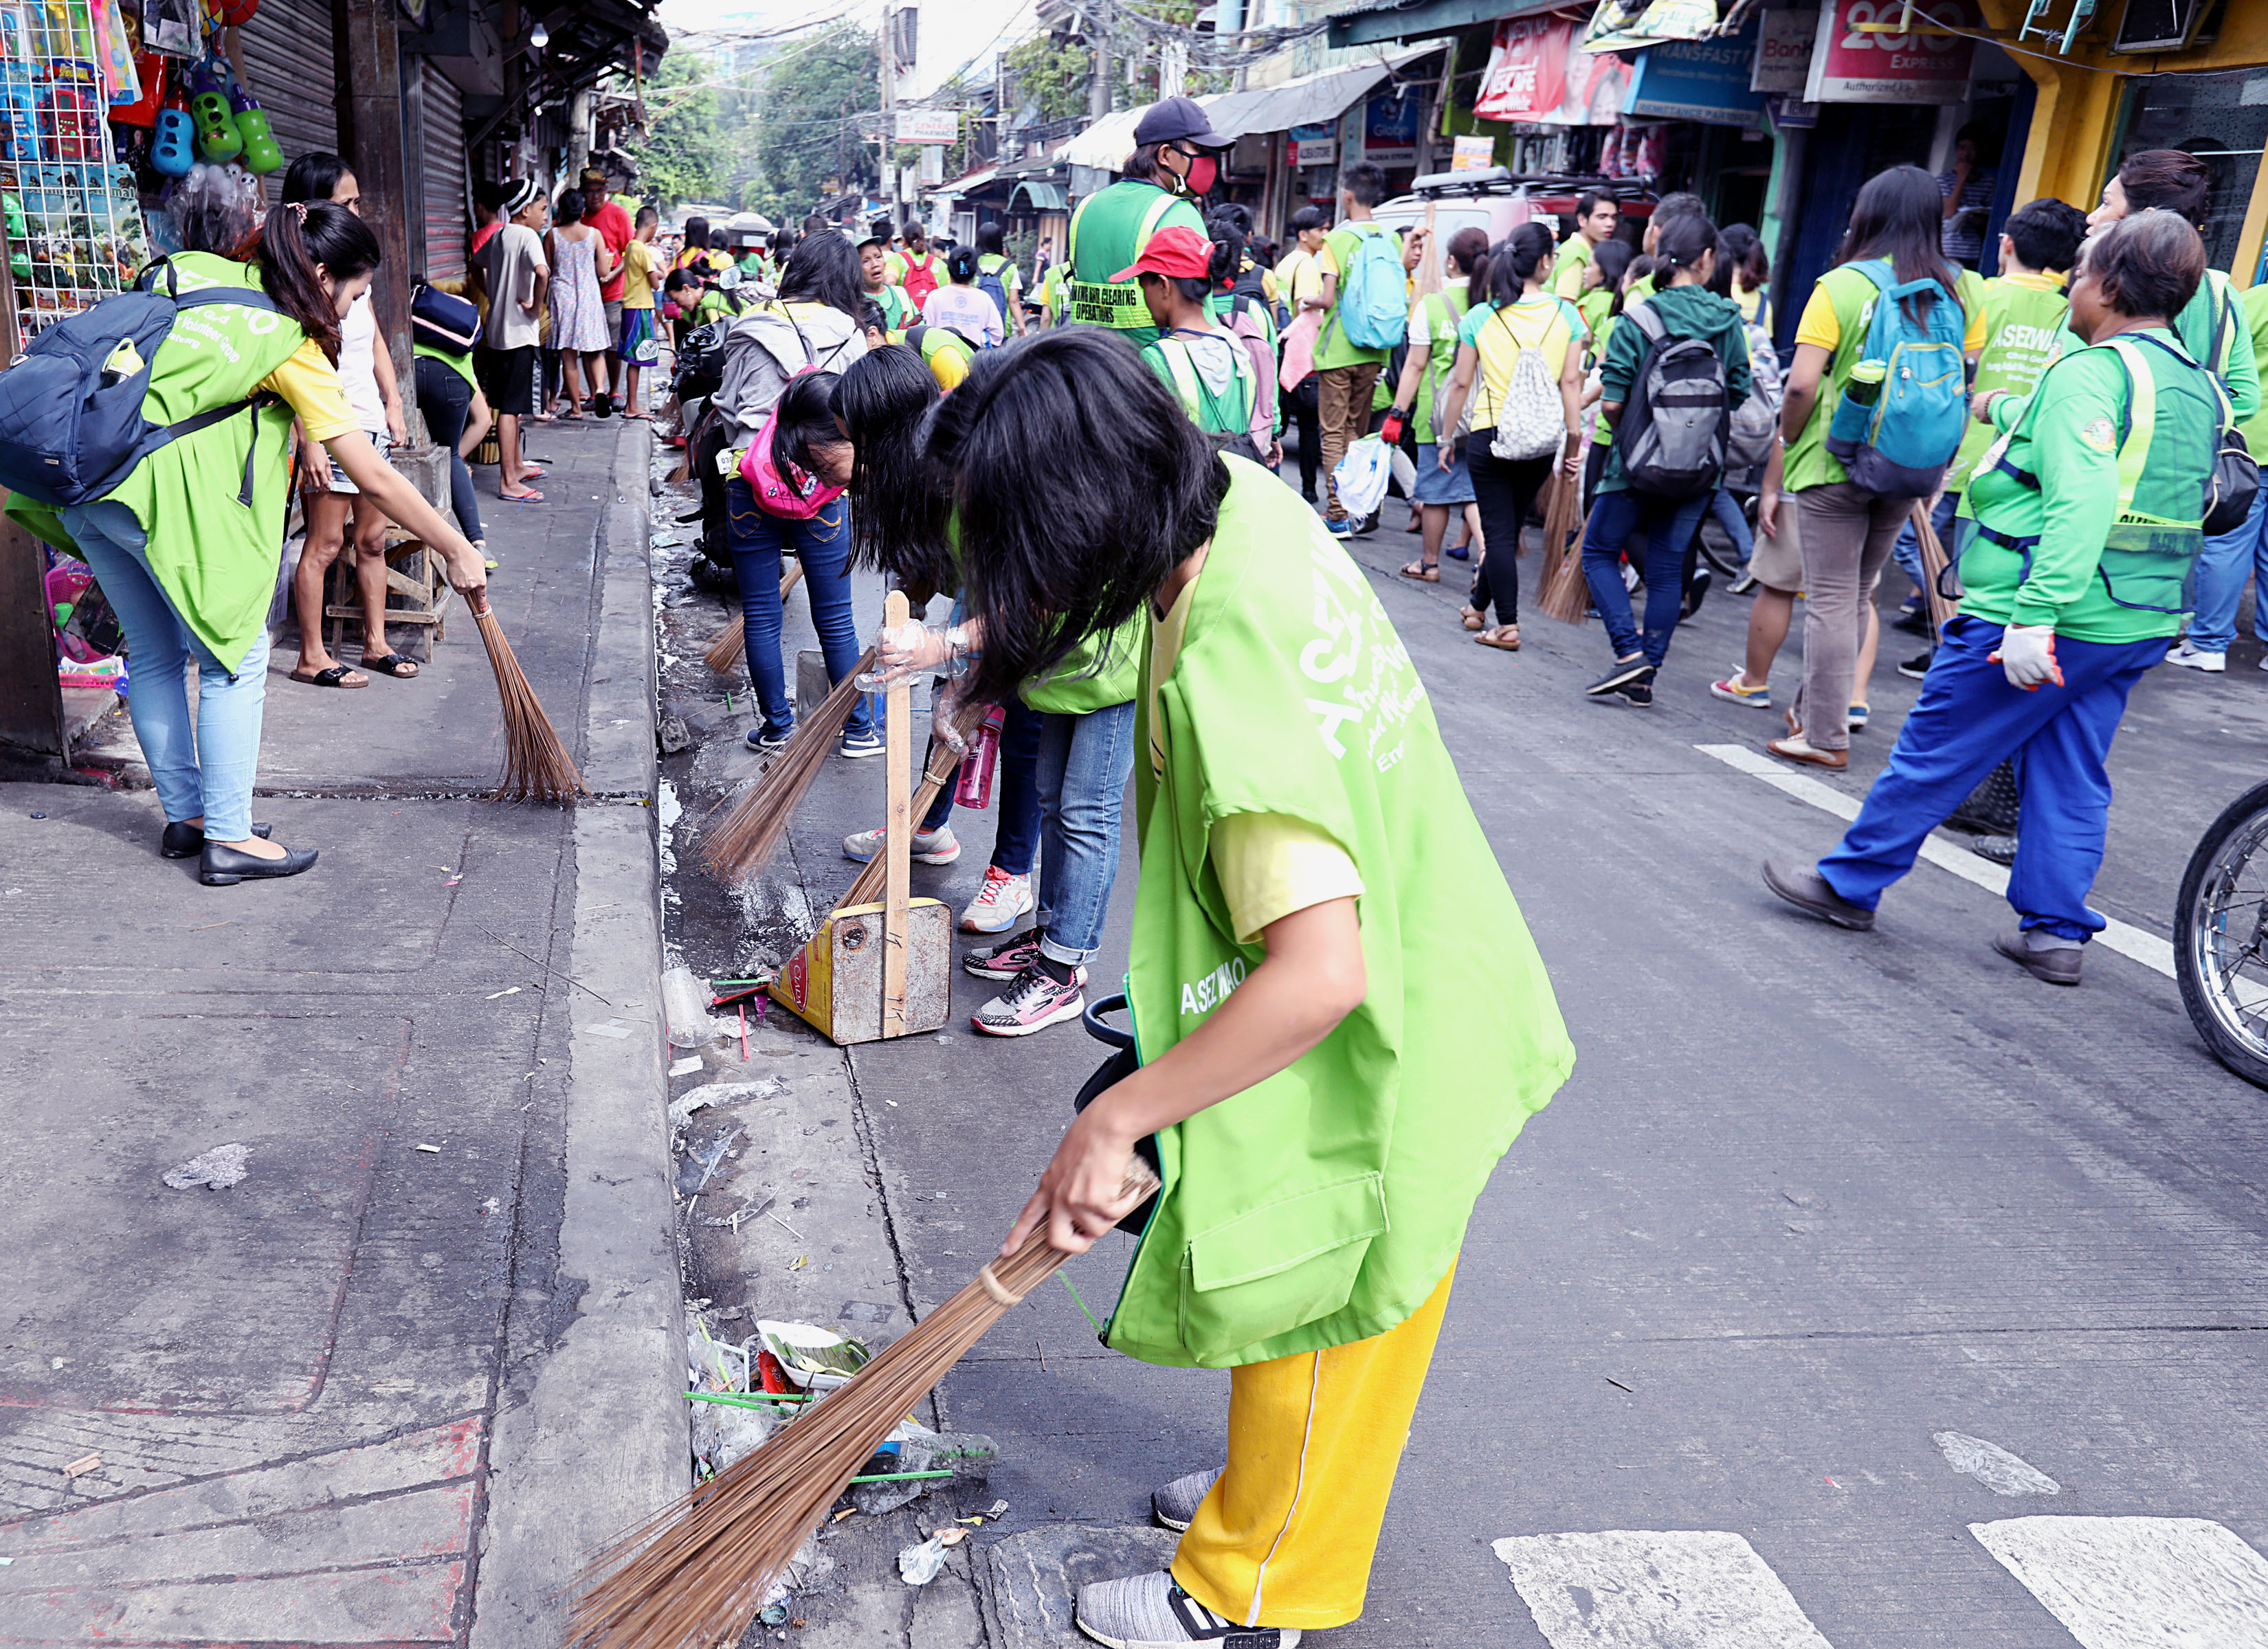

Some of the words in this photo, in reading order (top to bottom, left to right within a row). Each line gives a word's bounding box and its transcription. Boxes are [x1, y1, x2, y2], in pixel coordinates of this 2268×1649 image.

[1842, 81, 1896, 93] Authorized
[1373, 124, 1409, 137] Globe
[1101, 288, 1137, 306] CLEARING
[1076, 303, 1115, 324] OPERATIONS
[181, 315, 223, 341] Volunteer
[1180, 956, 1246, 1016] ASEZWAO
